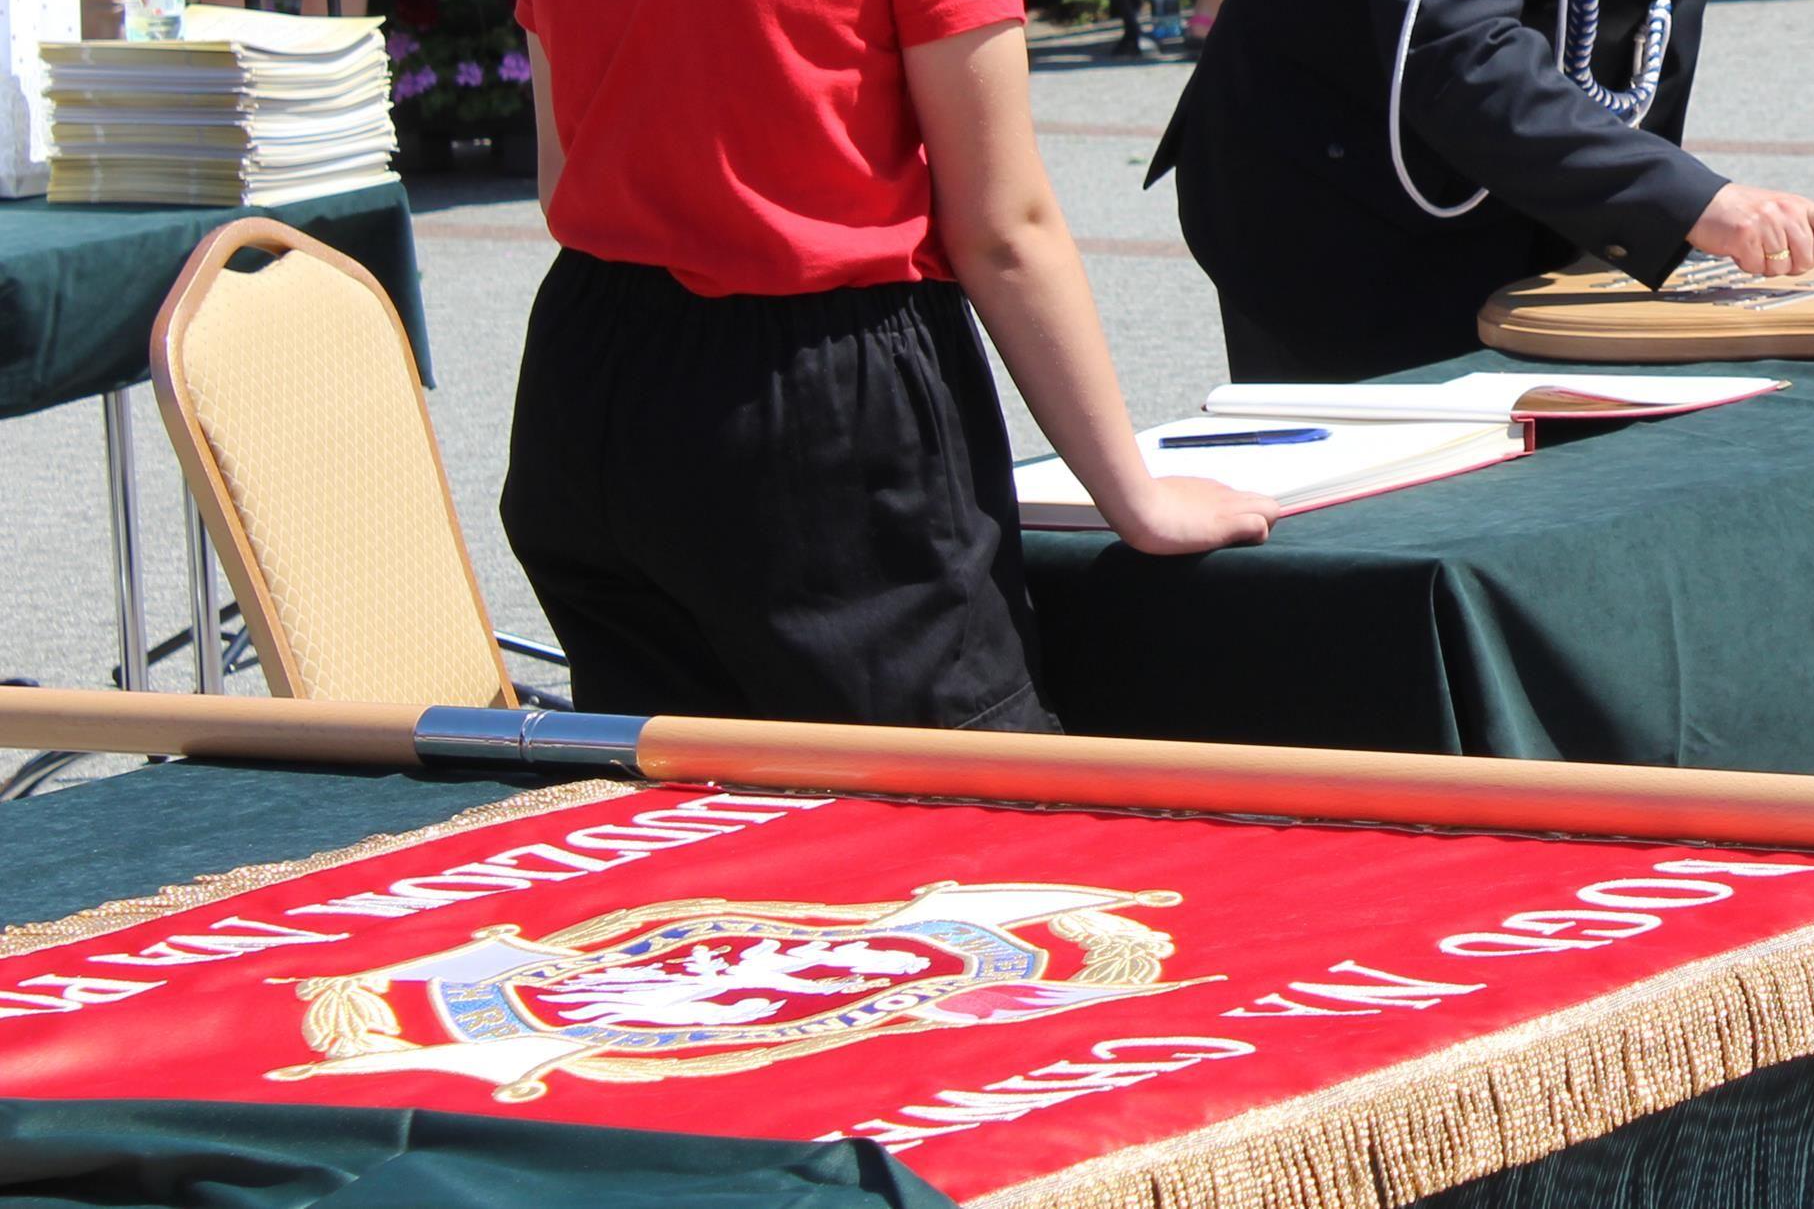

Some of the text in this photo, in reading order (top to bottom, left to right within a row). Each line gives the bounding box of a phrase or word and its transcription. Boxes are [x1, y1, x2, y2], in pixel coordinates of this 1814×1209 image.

[286, 793, 836, 917] LUDZIOM
[88, 916, 352, 967] NA
[1219, 960, 1488, 1017] NA
[811, 1036, 1256, 1155] CHWA
